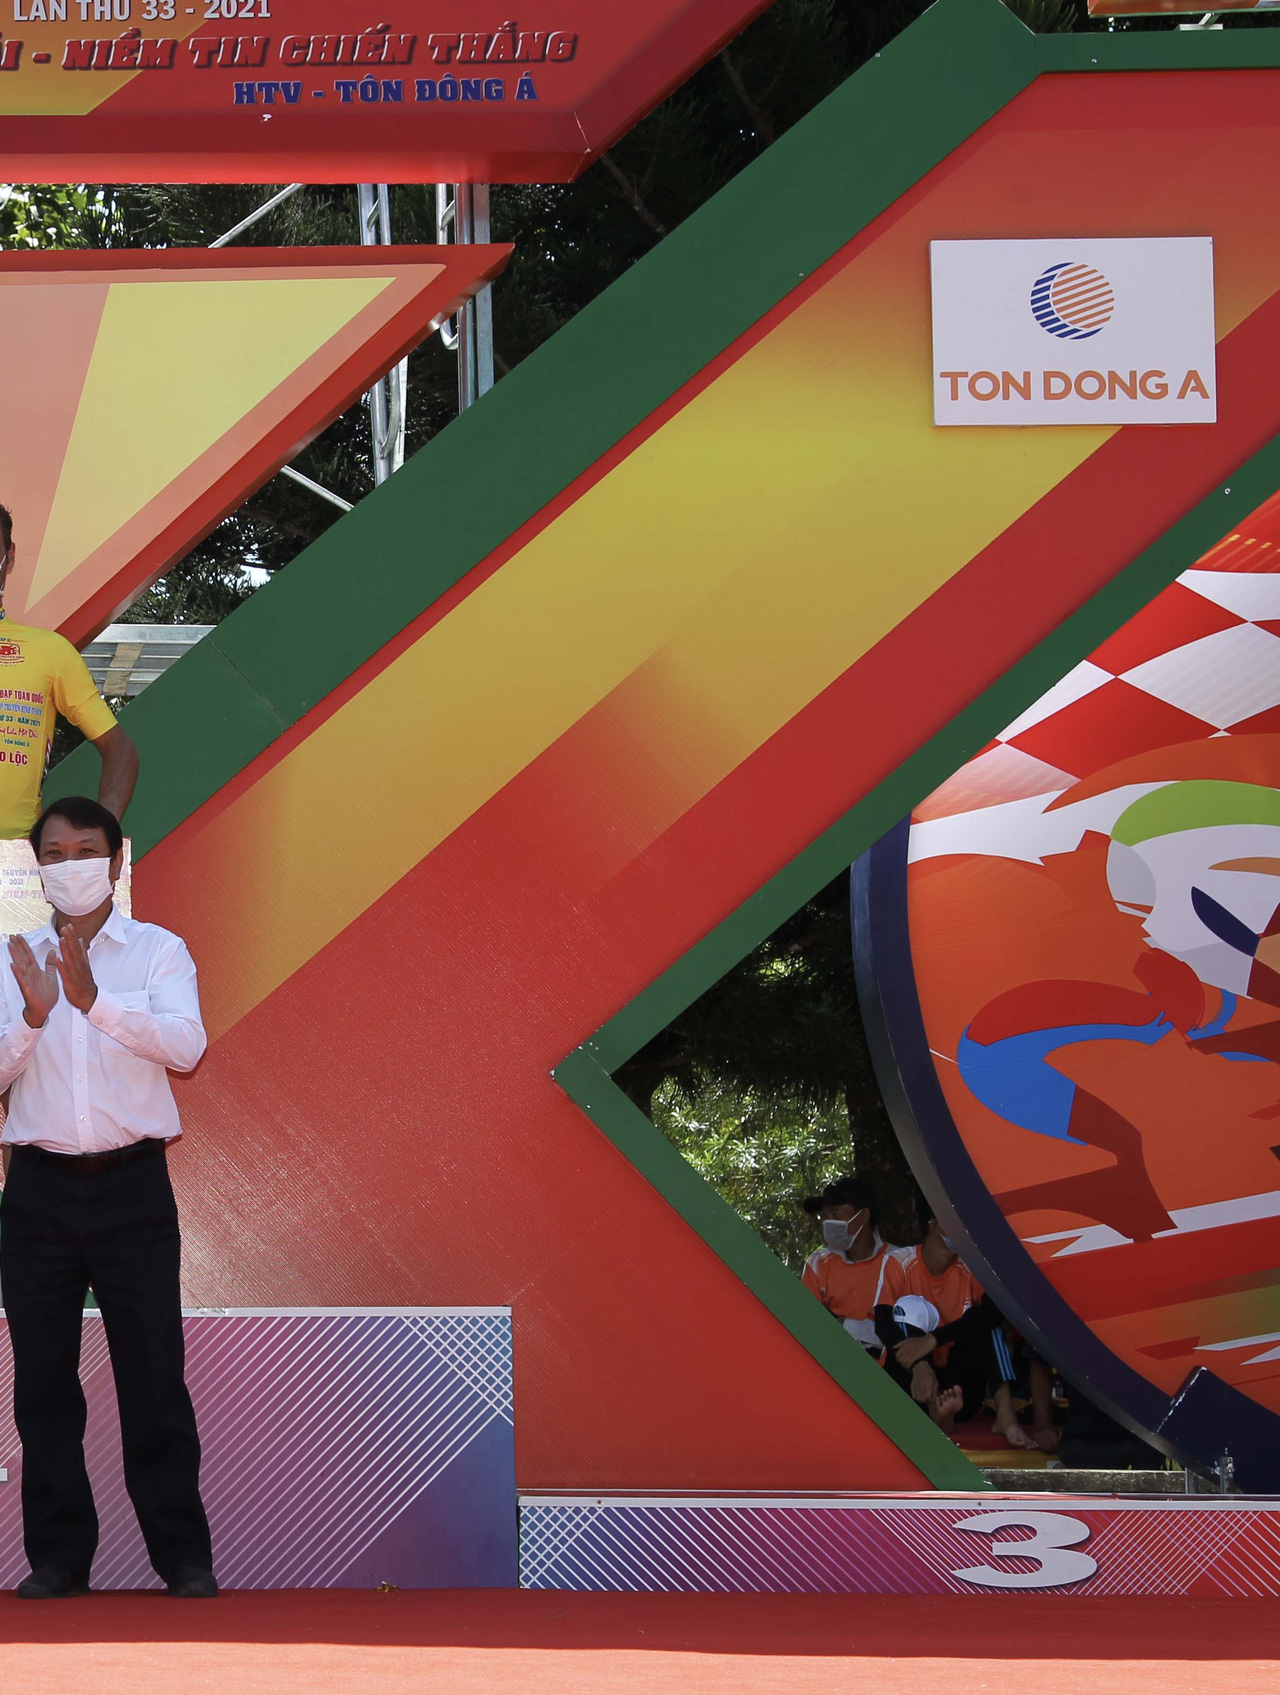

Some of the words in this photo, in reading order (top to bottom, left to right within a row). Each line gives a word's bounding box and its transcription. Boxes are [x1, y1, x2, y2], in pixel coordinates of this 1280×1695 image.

[142, 0, 176, 20] 33
[203, 0, 271, 19] 2021
[32, 52, 51, 64] -
[189, 36, 269, 69] TIN
[280, 22, 417, 66] CHIẾN
[427, 20, 579, 65] THẮNG
[233, 81, 302, 104] HTV
[334, 73, 404, 103] TÔN
[414, 73, 505, 102] ĐÔNG
[514, 70, 538, 101] Á
[939, 370, 1032, 401] TON
[1043, 369, 1169, 401] DONG
[1176, 369, 1210, 400] A
[9, 750, 28, 767] LỘC
[950, 1510, 1098, 1588] 3
